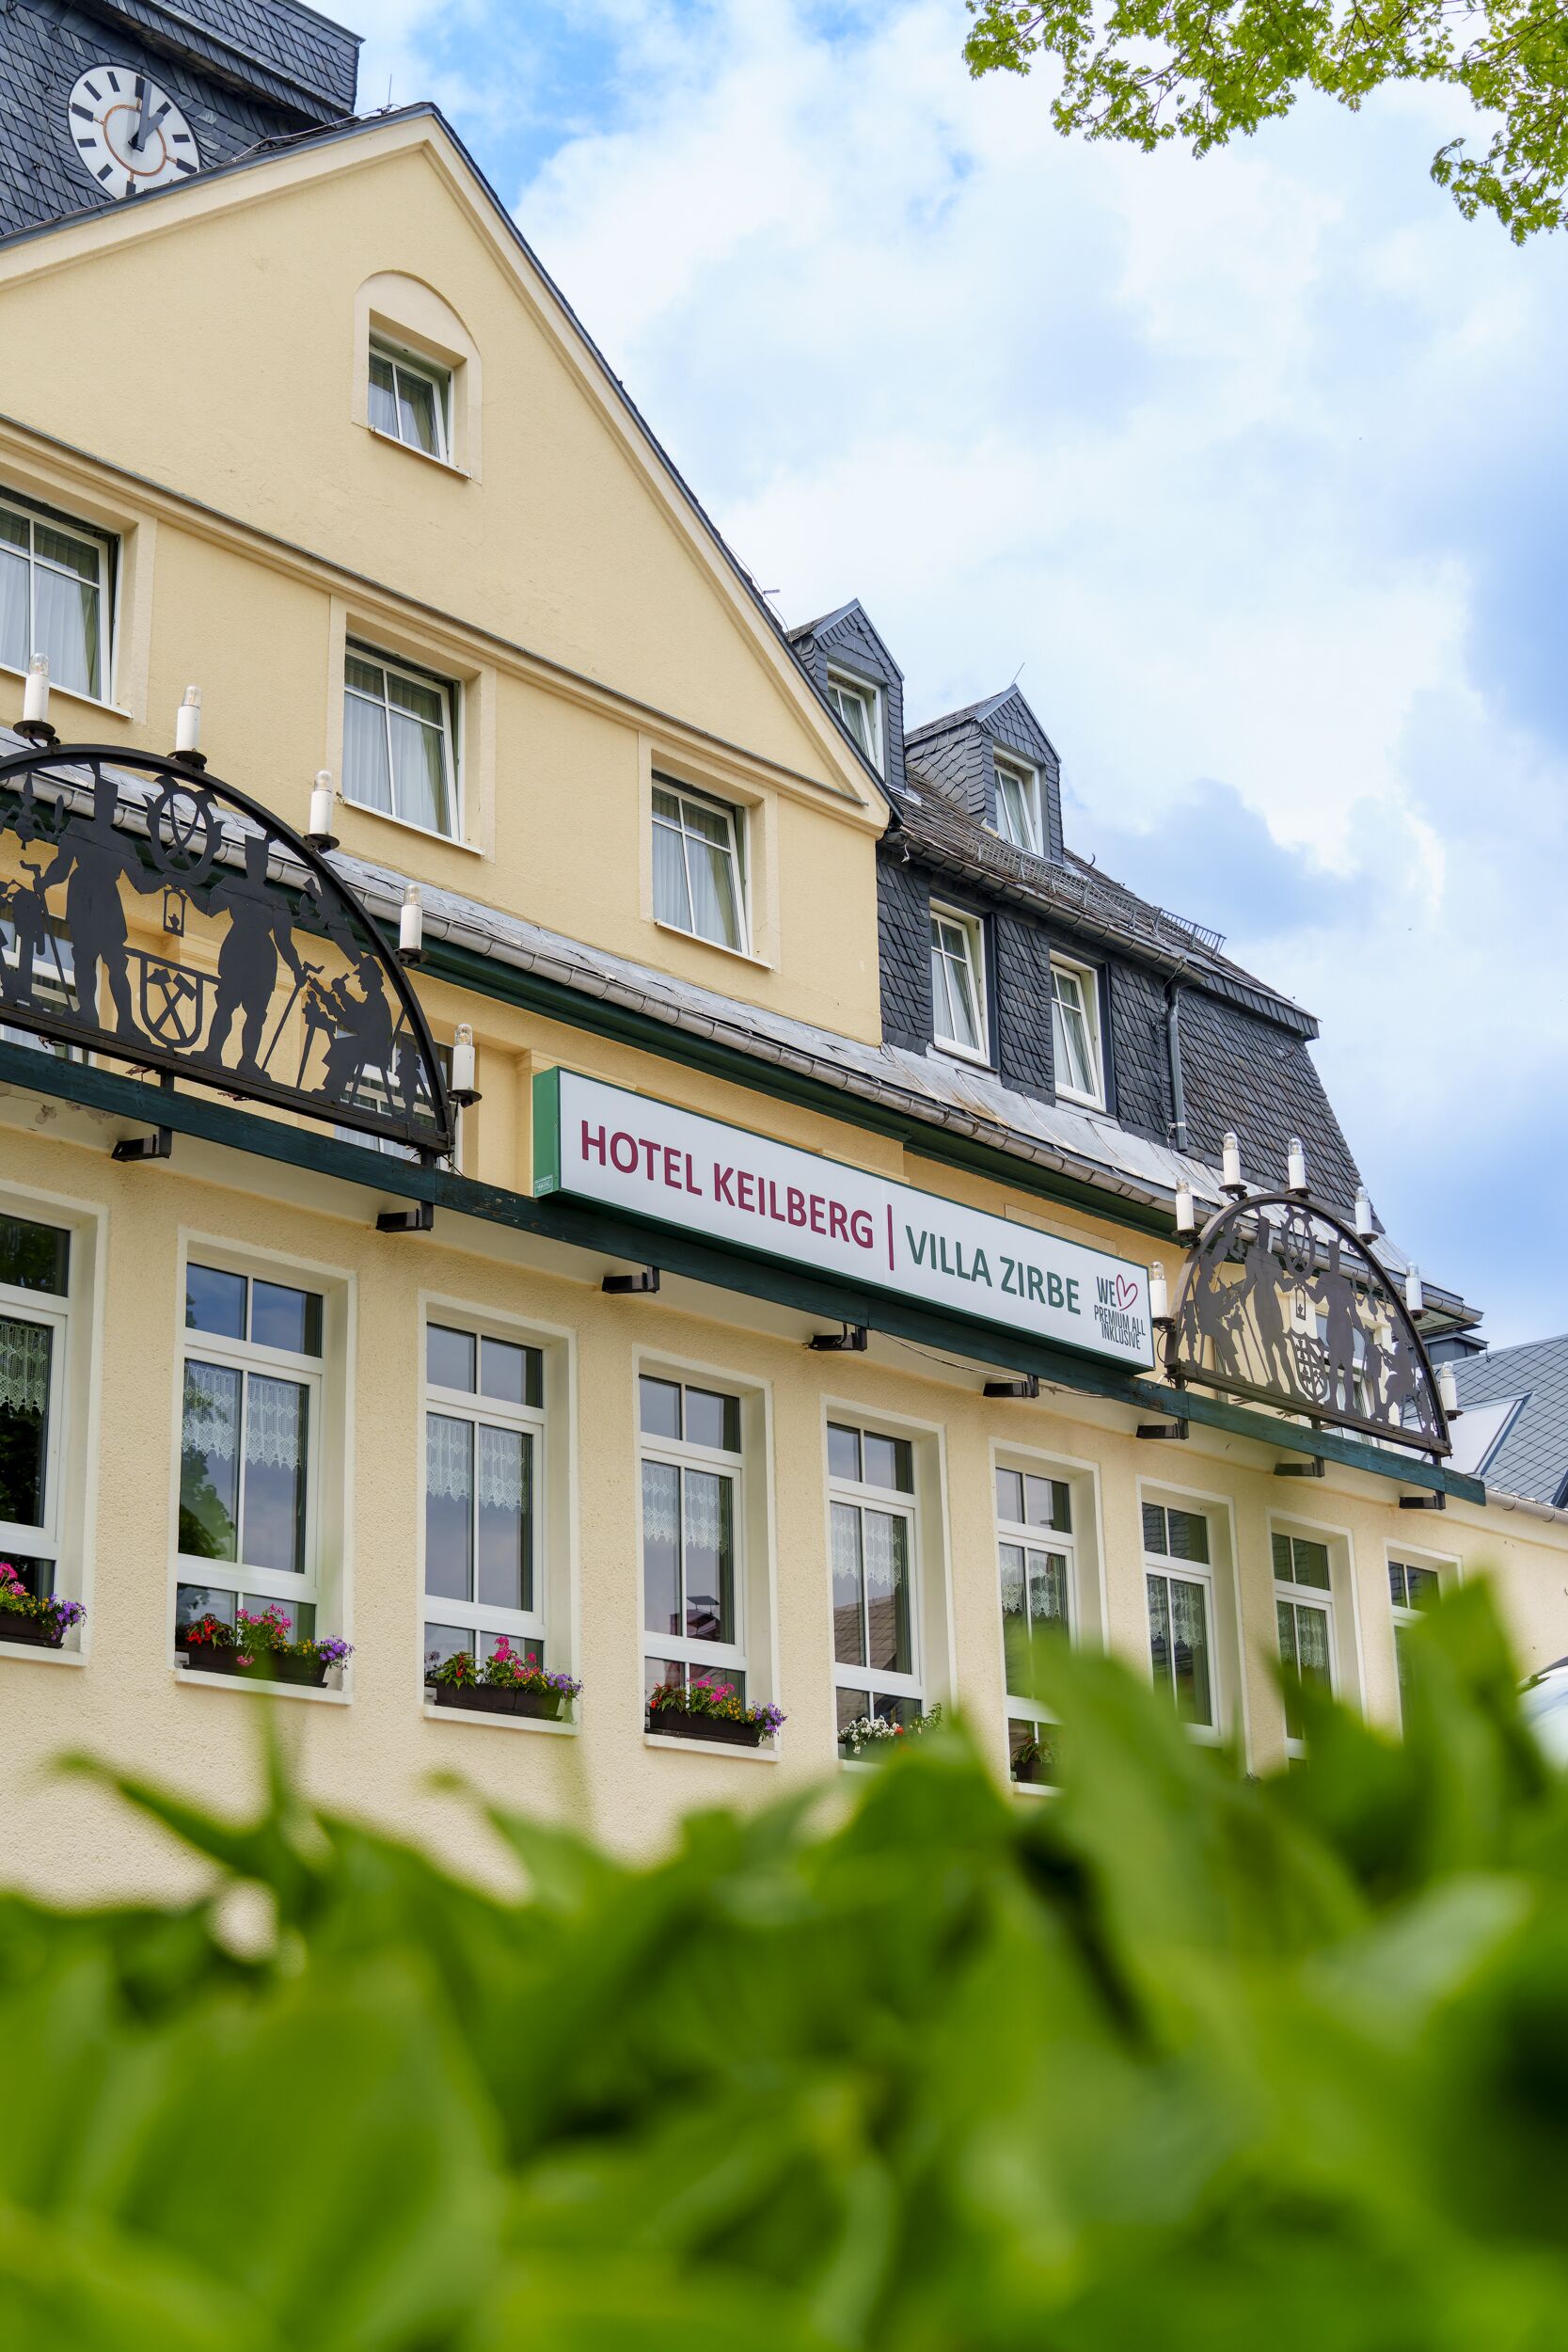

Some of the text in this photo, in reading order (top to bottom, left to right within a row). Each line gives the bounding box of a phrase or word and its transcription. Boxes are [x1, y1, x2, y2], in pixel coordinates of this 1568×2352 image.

[581, 1120, 1082, 1315] HOTEL KEILBERG VILLA ZIRBE
[1096, 1276, 1117, 1308] WE
[1094, 1304, 1146, 1336] PREMIUM ALL
[1101, 1322, 1141, 1350] INKLUSIVE
